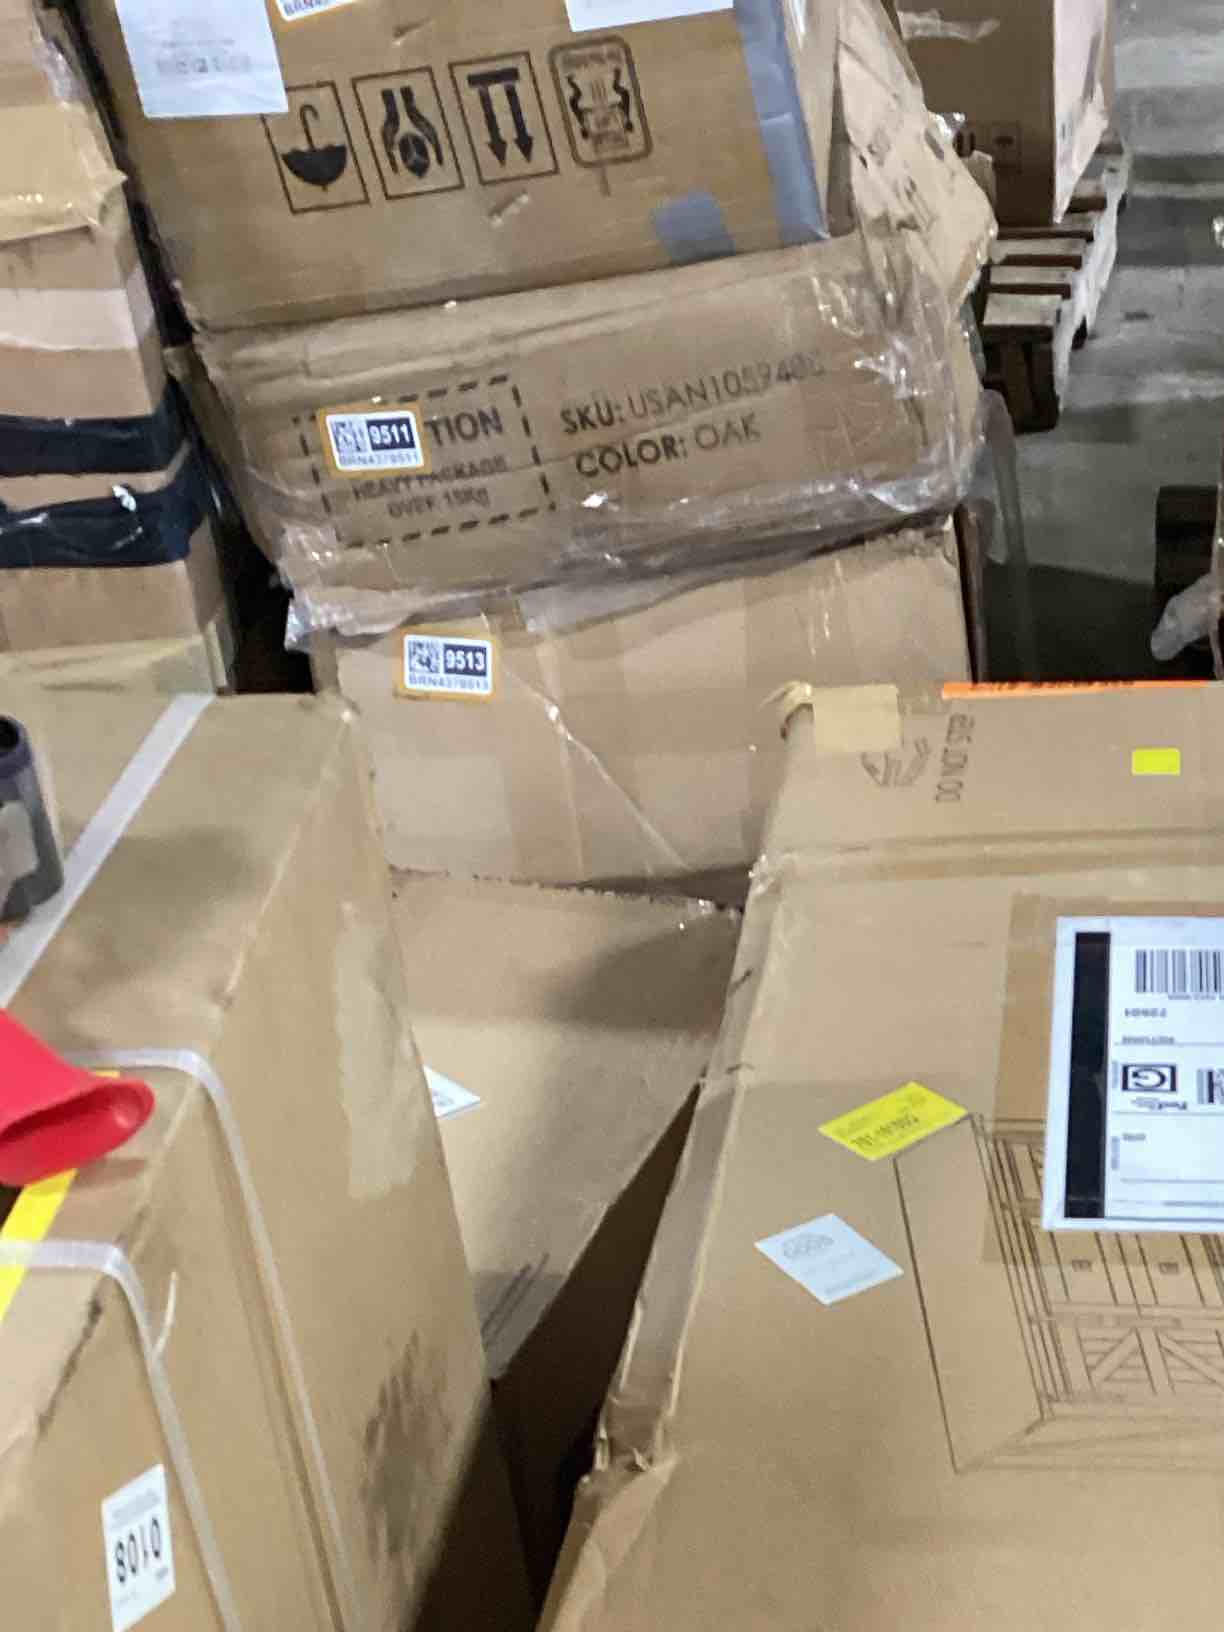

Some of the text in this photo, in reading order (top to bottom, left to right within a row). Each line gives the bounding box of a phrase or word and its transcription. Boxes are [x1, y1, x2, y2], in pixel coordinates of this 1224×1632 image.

[368, 423, 411, 446] 9511
[425, 405, 503, 449] TION
[560, 398, 625, 435] SKU:
[575, 411, 761, 478] COLOR: OAK
[446, 649, 486, 671] 9513
